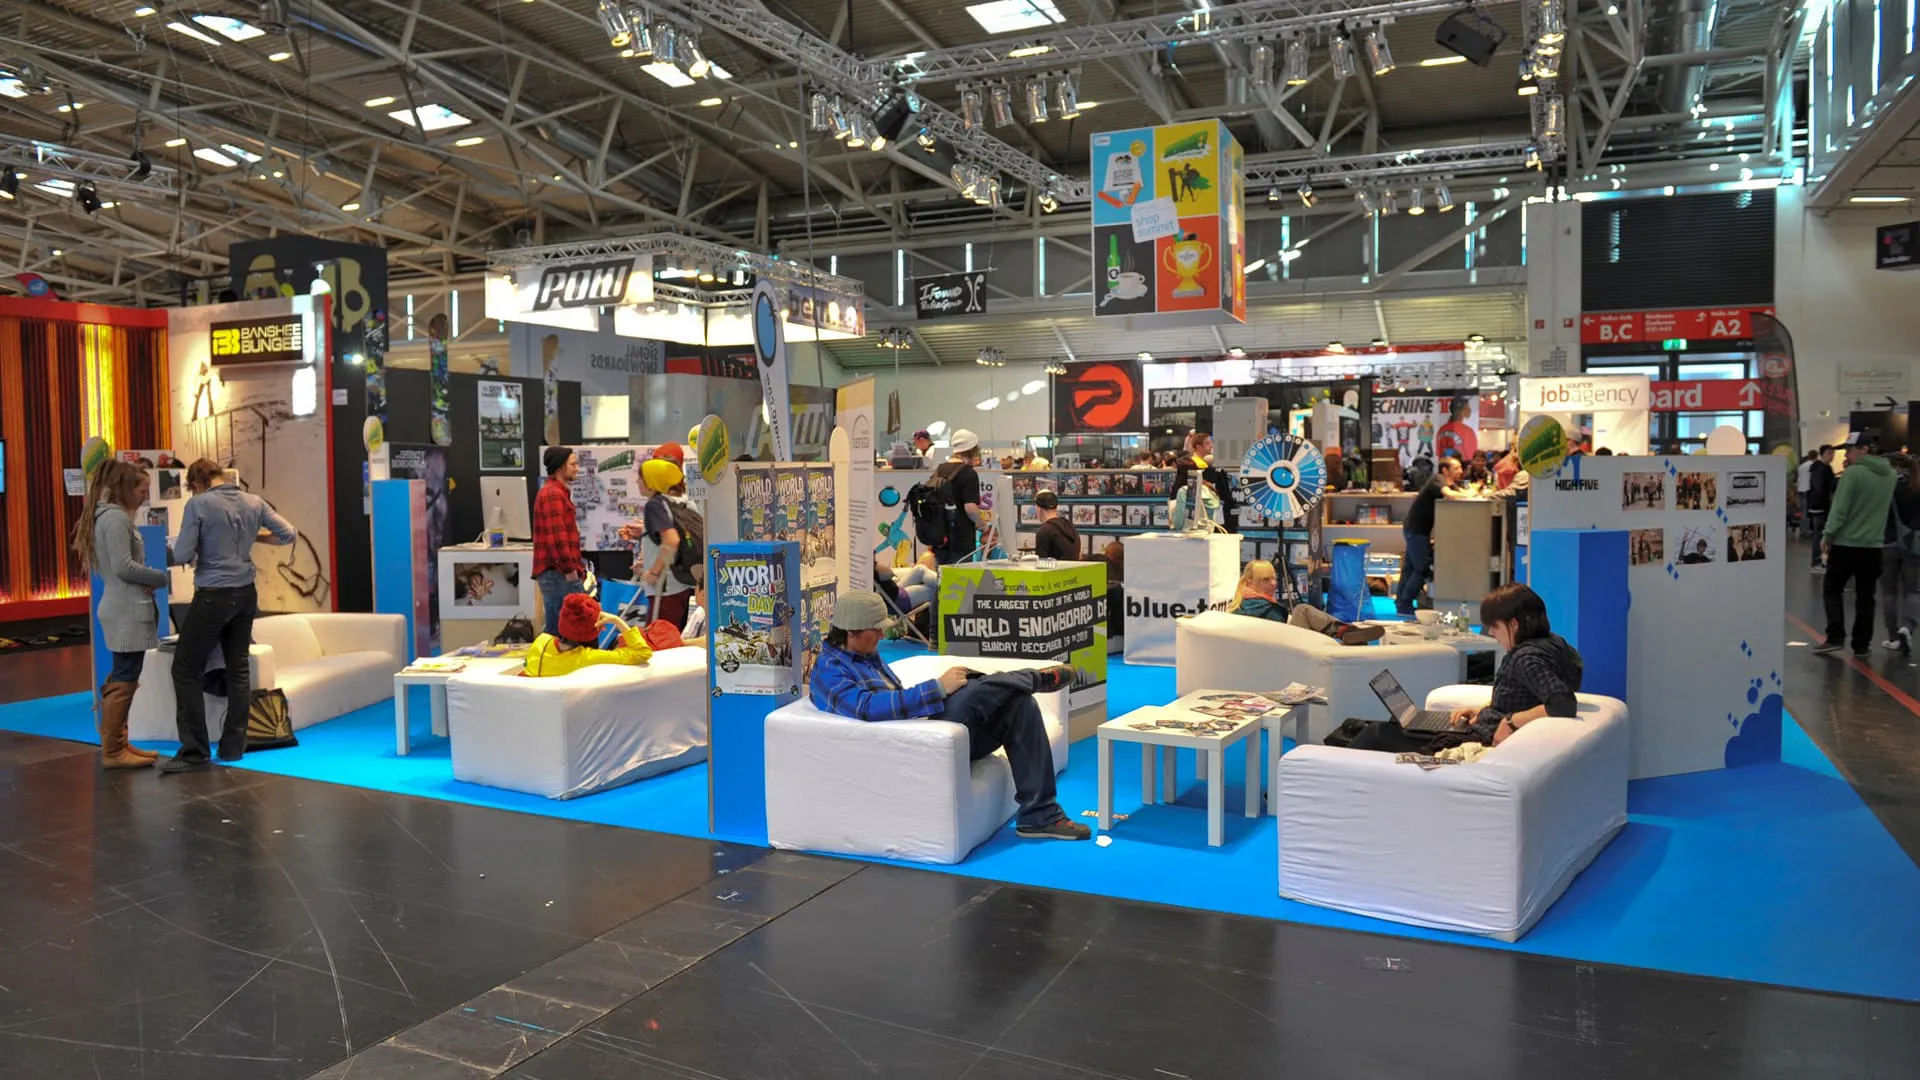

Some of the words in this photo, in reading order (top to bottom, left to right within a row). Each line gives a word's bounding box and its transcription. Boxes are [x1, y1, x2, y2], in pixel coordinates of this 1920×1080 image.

[533, 258, 636, 311] POW
[241, 323, 302, 339] BANSHEE
[1600, 323, 1633, 343] B,C
[1711, 319, 1741, 337] A2
[241, 335, 302, 354] BUNGEE
[1153, 388, 1222, 408] TECHNINE
[744, 478, 772, 498] WORLD
[780, 477, 804, 497] WORLD
[812, 475, 833, 494] WORLD
[1555, 480, 1578, 491] HIGH
[1579, 480, 1599, 491] FIVE
[727, 564, 784, 587] WORLD
[748, 594, 776, 615] DAY
[977, 599, 992, 609] THE
[994, 599, 1029, 610] LARGEST
[1033, 599, 1055, 610] EVENT
[1073, 588, 1091, 601] WORLD
[951, 617, 1011, 638] WORLD
[1018, 604, 1093, 637] SNOWBOARD
[982, 641, 1018, 652] SUNDAY
[1021, 638, 1063, 654] DECEMBER
